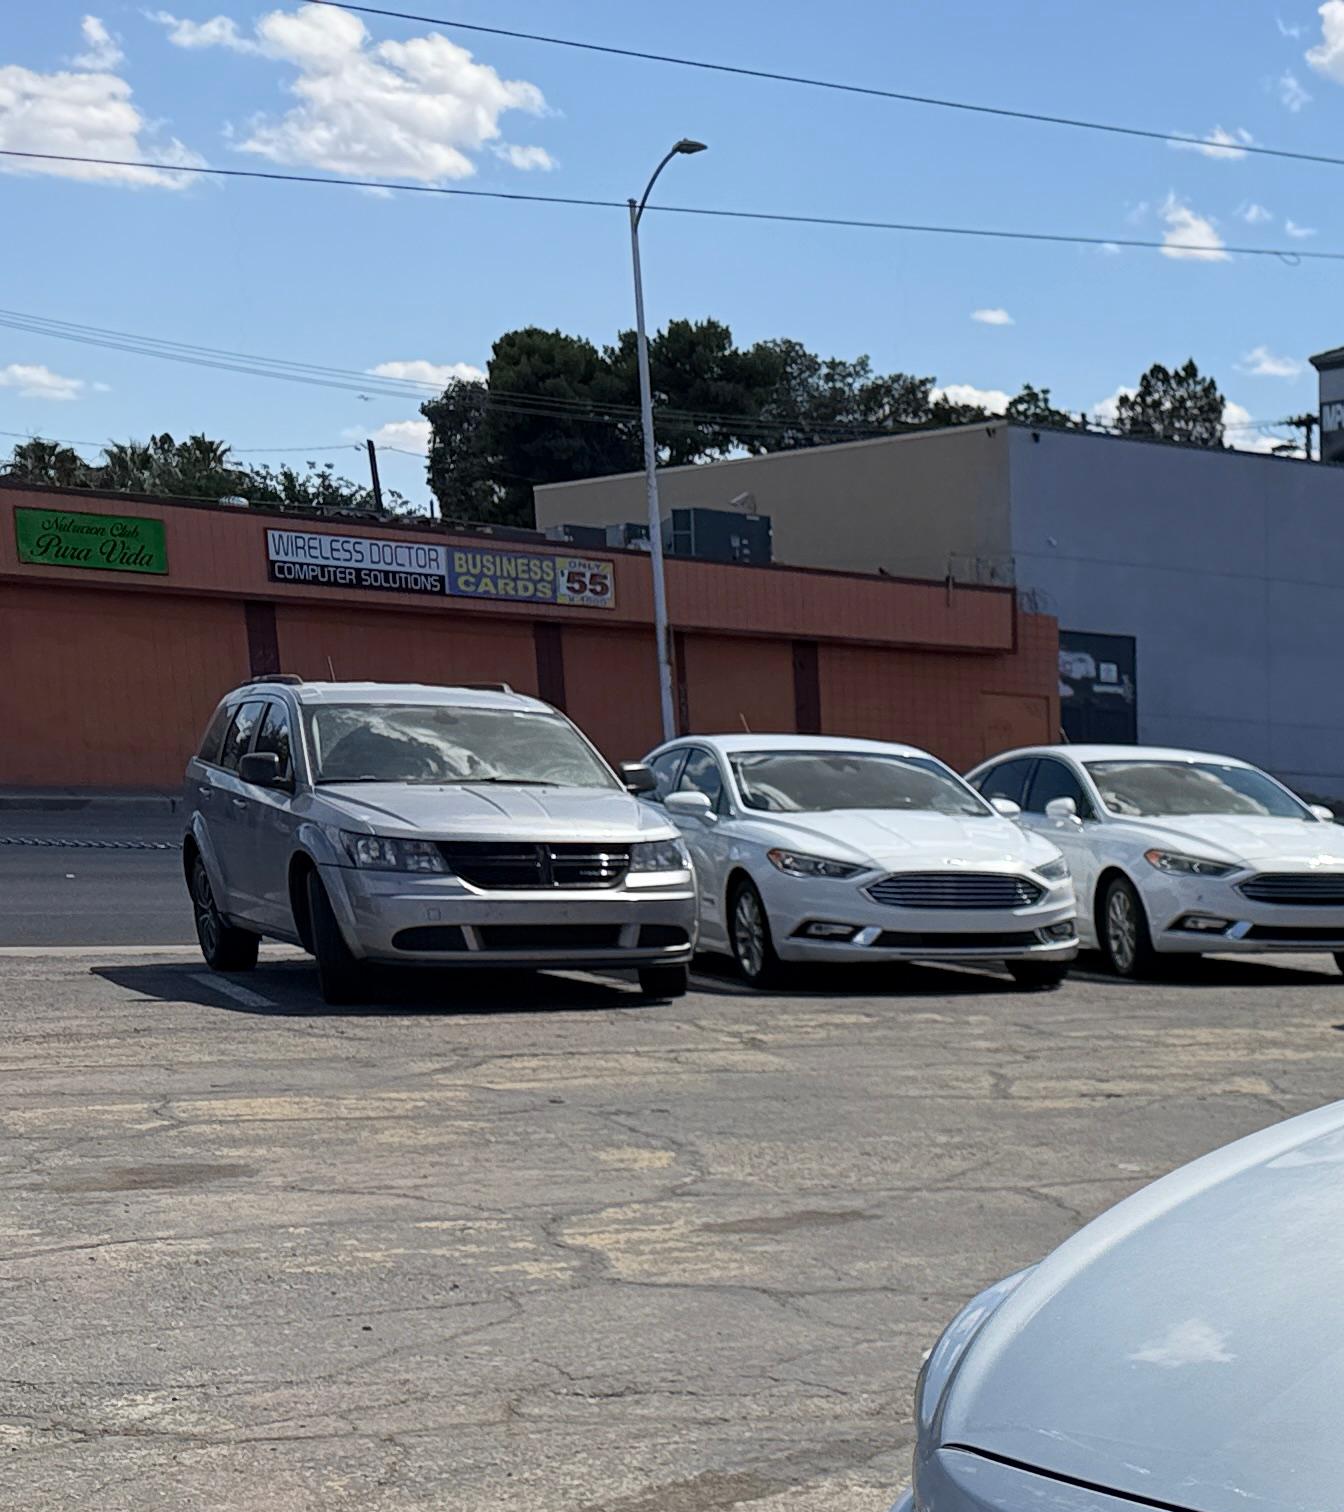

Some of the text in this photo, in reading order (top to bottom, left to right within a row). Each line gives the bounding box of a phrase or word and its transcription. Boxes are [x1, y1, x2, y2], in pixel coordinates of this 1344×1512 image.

[109, 522, 139, 539] Club
[31, 533, 153, 567] Pura Vida
[272, 533, 440, 571] WIRELESS DOCTOR
[274, 562, 441, 592] COMPUTER SOLUTIONS
[454, 551, 554, 581] BUSINESS
[457, 575, 553, 598] CARDS
